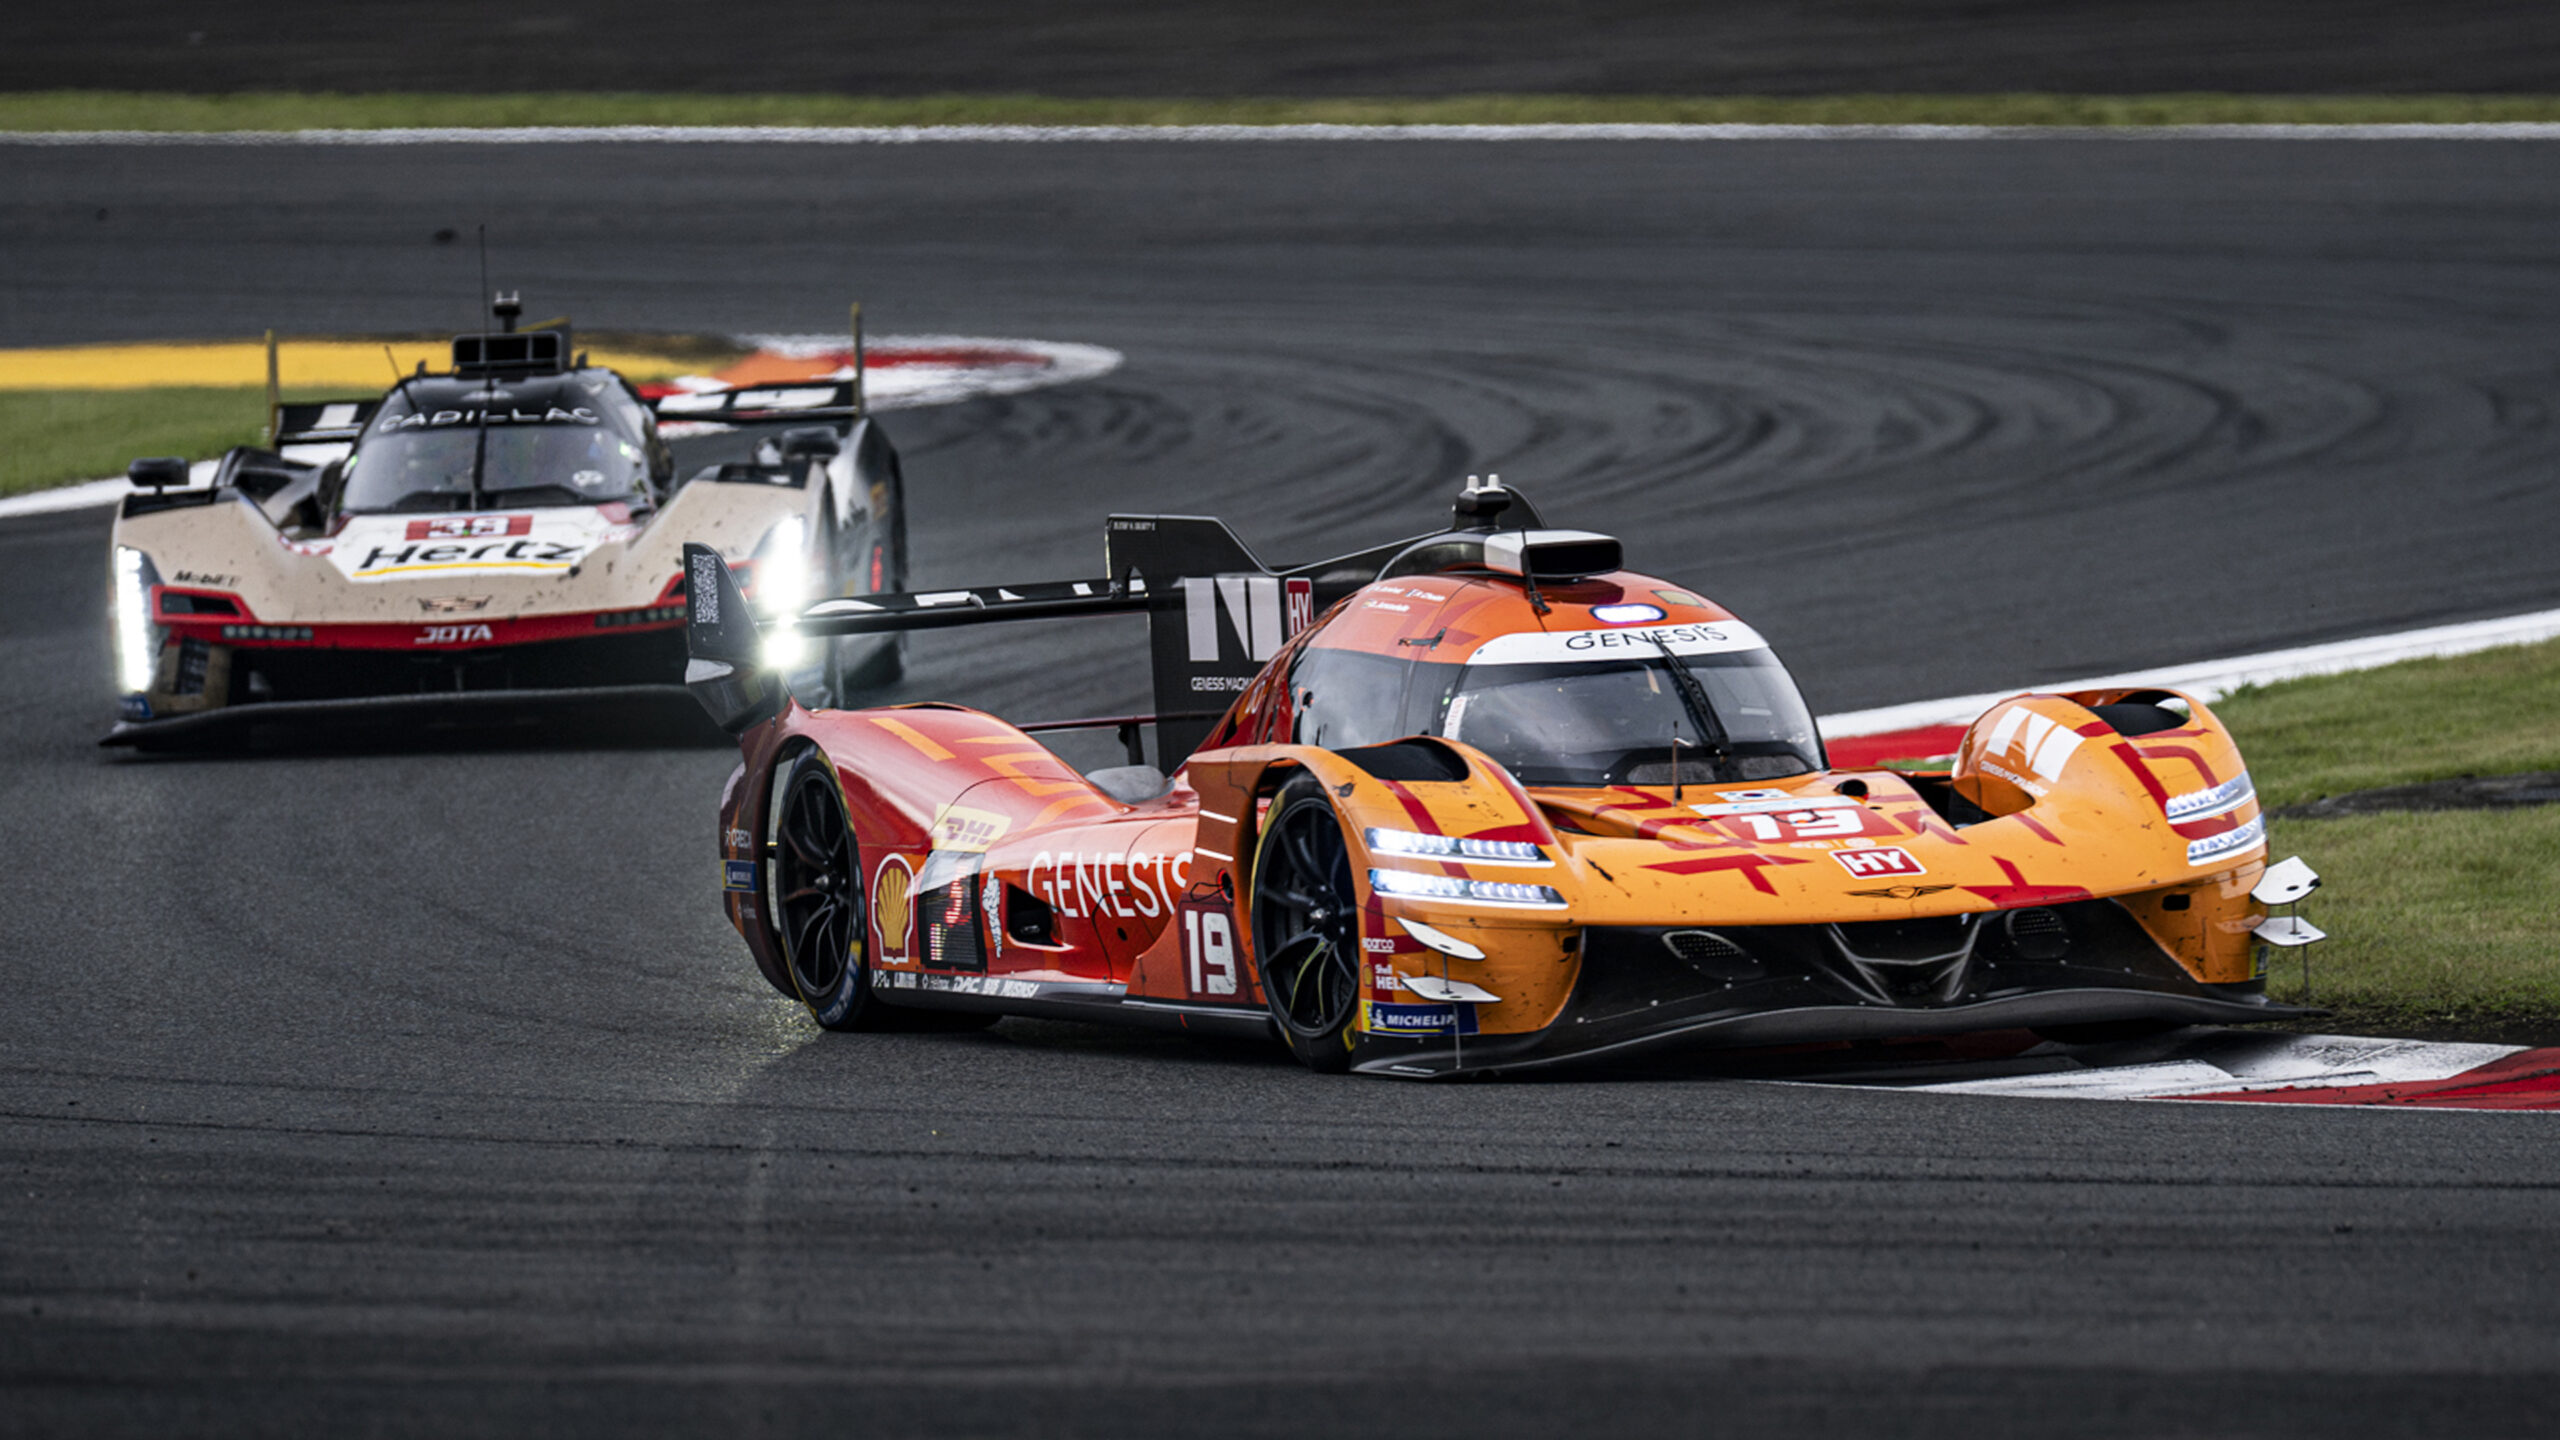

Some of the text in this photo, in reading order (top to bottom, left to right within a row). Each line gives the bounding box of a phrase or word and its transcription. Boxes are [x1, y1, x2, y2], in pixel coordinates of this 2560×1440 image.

[379, 407, 599, 433] CADILLAC
[359, 541, 586, 569] Hertz
[1288, 593, 1312, 636] HY
[415, 623, 493, 645] JOTA
[1565, 624, 1728, 651] GENESIS
[1191, 676, 1225, 691] GENESIS
[945, 817, 997, 846] DHL
[1740, 809, 1864, 841] 19
[1841, 851, 1906, 874] HY
[1185, 909, 1237, 995] 19
[1361, 937, 1395, 952] sparco
[1374, 964, 1393, 975] Shell
